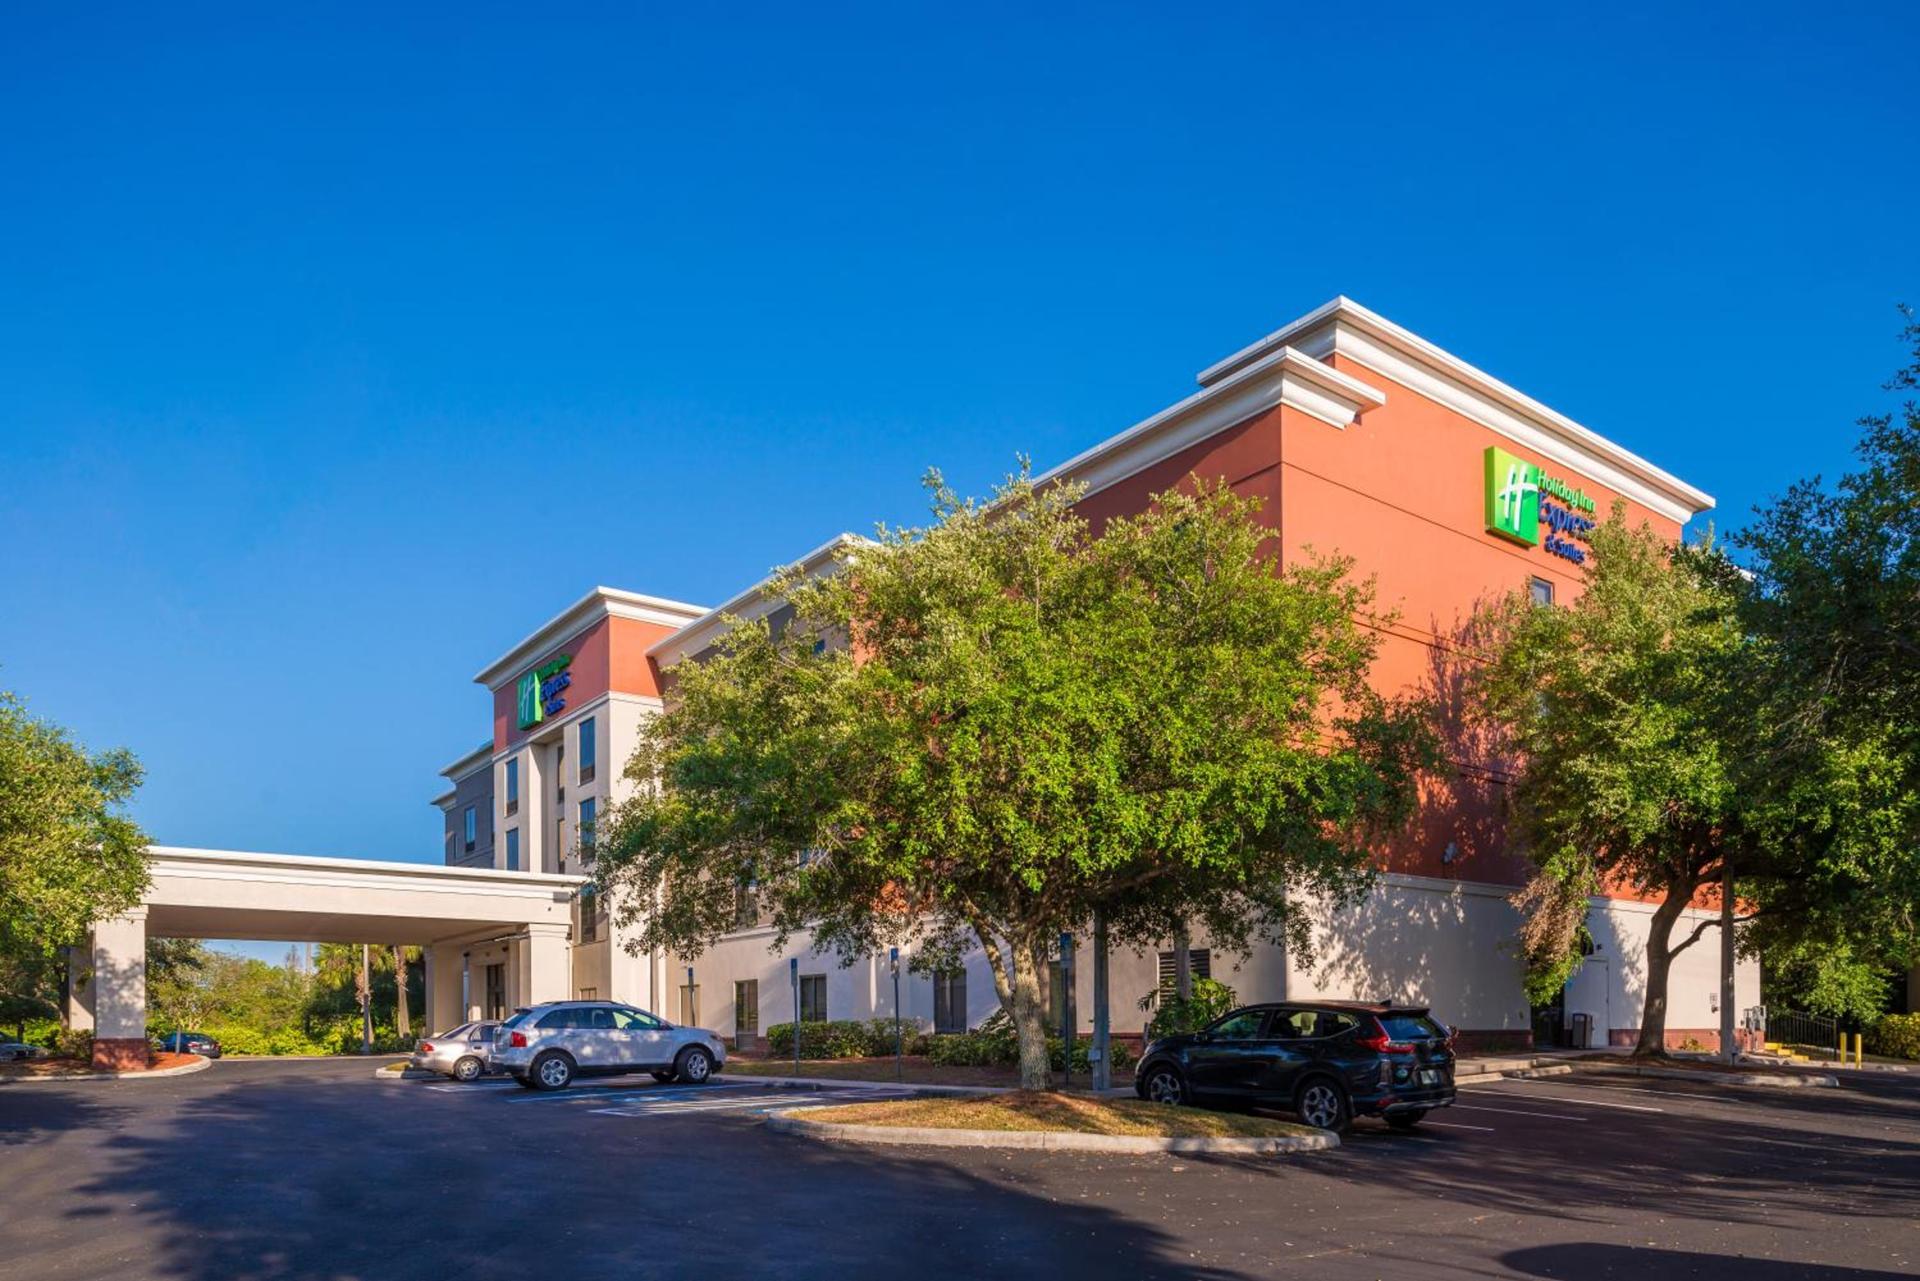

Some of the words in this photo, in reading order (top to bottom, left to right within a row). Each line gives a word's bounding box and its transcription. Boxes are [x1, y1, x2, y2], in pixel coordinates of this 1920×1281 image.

[1537, 468, 1578, 507] Holiday
[1579, 489, 1596, 513] Inn
[1554, 538, 1585, 563] Suites
